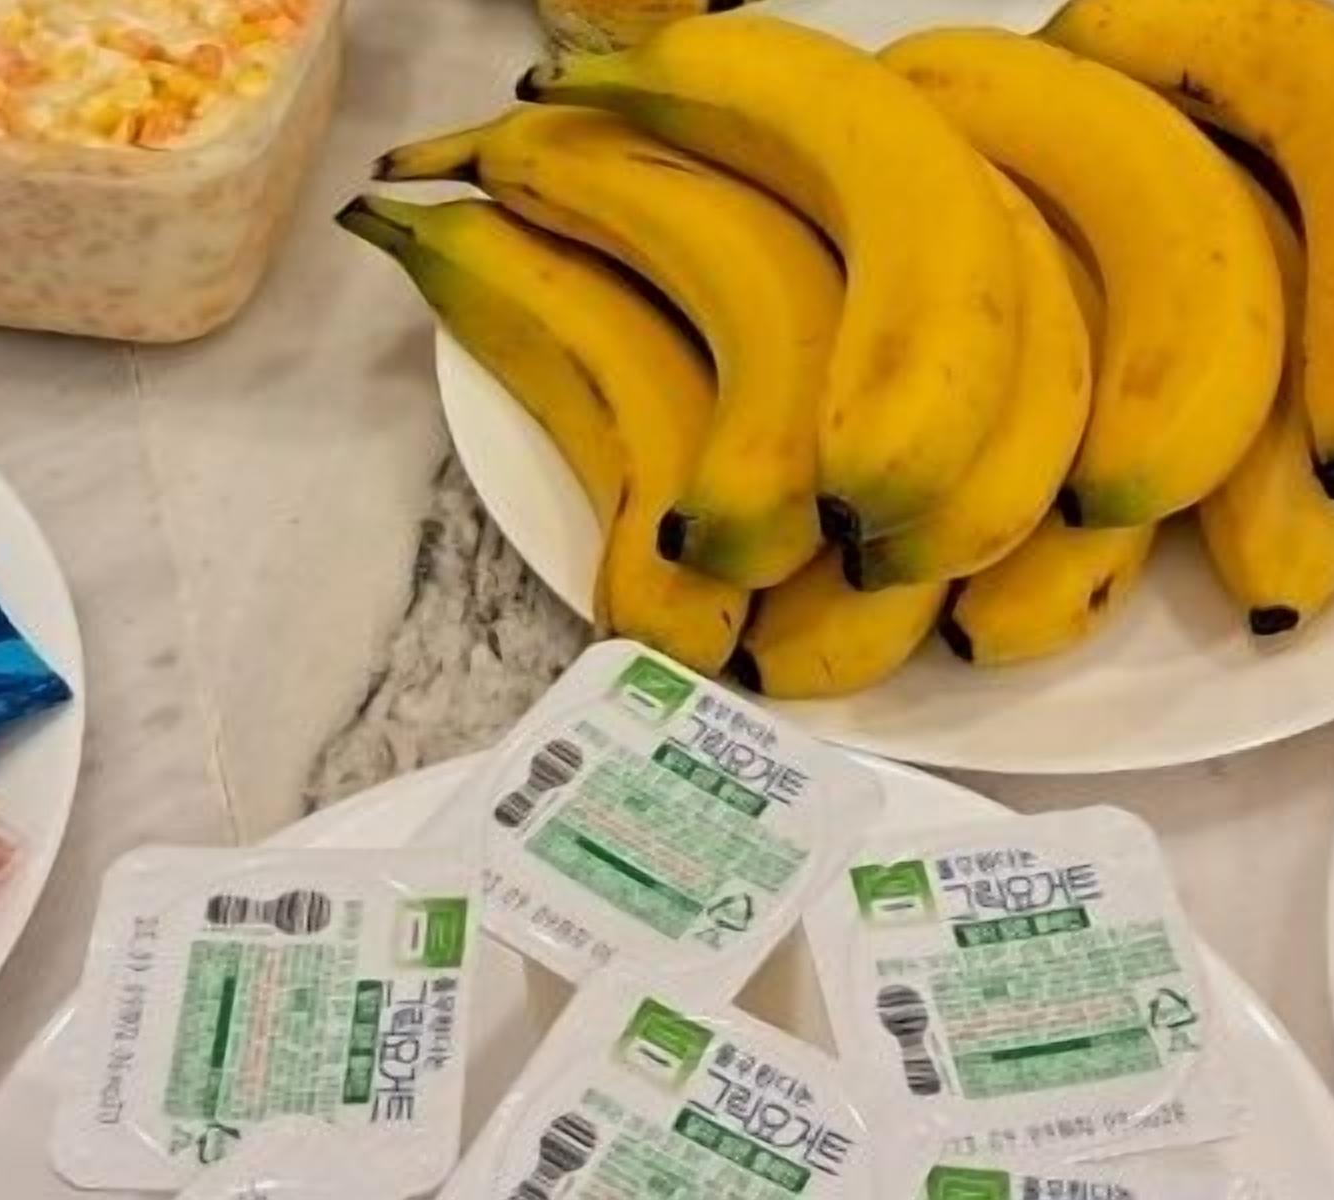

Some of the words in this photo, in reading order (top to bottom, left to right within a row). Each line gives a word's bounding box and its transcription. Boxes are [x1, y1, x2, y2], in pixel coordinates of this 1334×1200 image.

[945, 863, 1105, 922] 그릭요거트
[370, 980, 428, 1124] 그릭요거트
[687, 1068, 858, 1178] 그릭요거트
